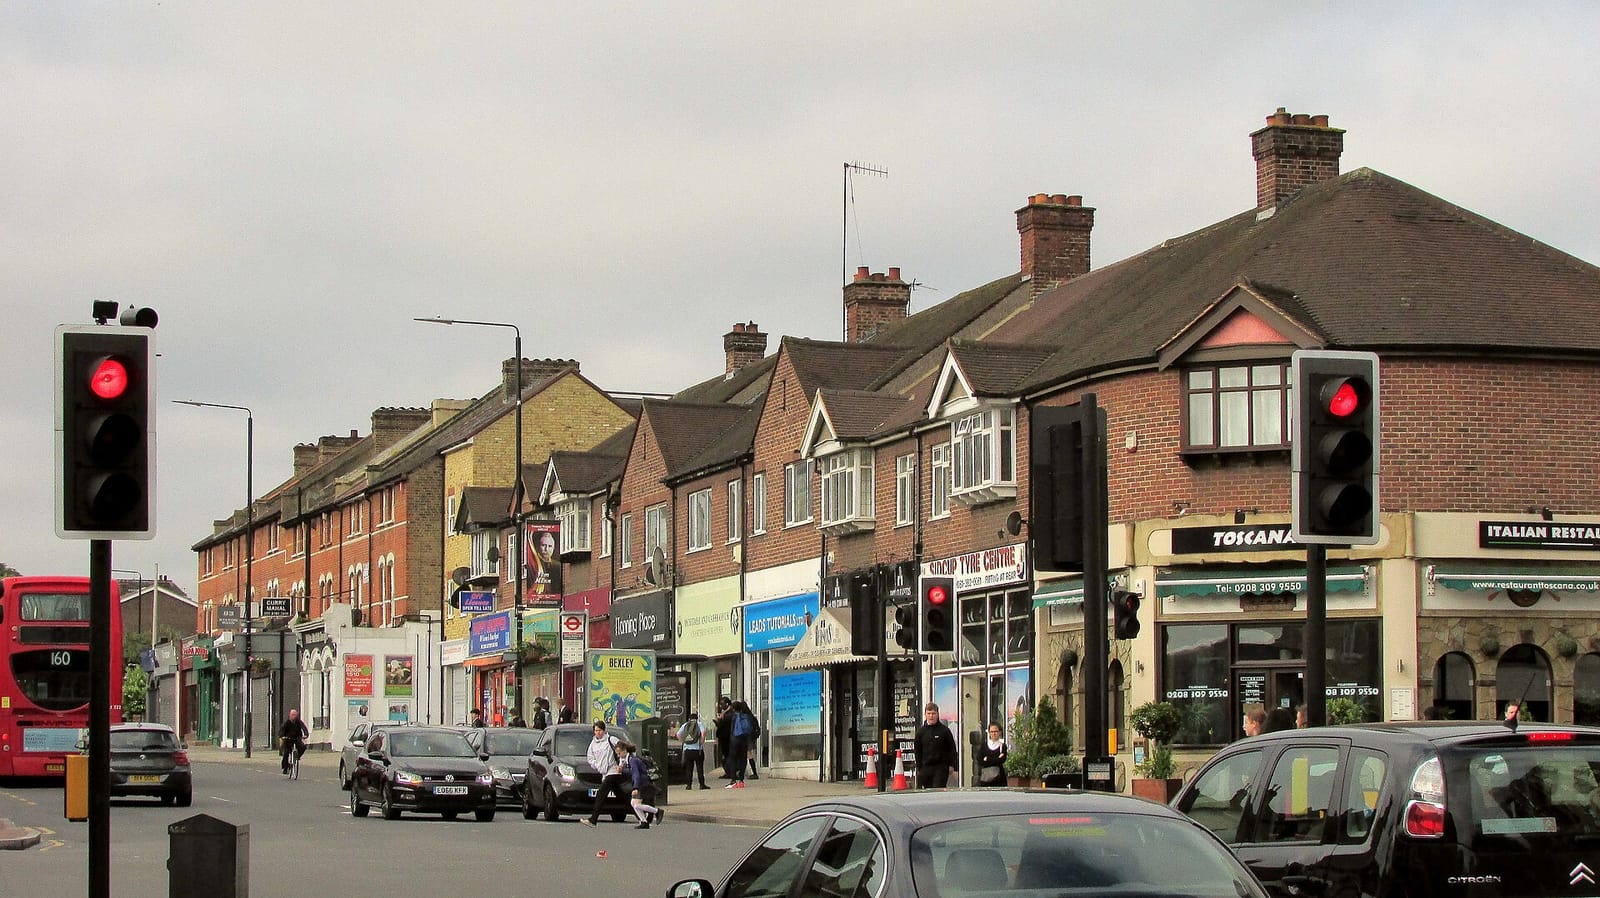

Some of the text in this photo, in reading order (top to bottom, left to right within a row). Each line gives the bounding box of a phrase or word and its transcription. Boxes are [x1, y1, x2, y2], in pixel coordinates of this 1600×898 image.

[1487, 525, 1547, 538] ITALIAN
[1213, 529, 1296, 546] TOSCANA
[930, 546, 1015, 575] SIDCUP TYRE CENTRE
[1216, 582, 1302, 593] Tel: 0208 309 9550
[1472, 581, 1600, 590] www.restauranttoscana.co.uk
[584, 595, 590, 606] L
[748, 618, 766, 634] LEADS
[766, 613, 796, 631] TUTORIALS
[51, 651, 71, 665] 160
[609, 658, 634, 668] BEXLEY
[1191, 690, 1206, 698] 309
[1326, 688, 1337, 696] 08
[1339, 688, 1356, 696] 309
[1447, 875, 1501, 885] CITROËN
